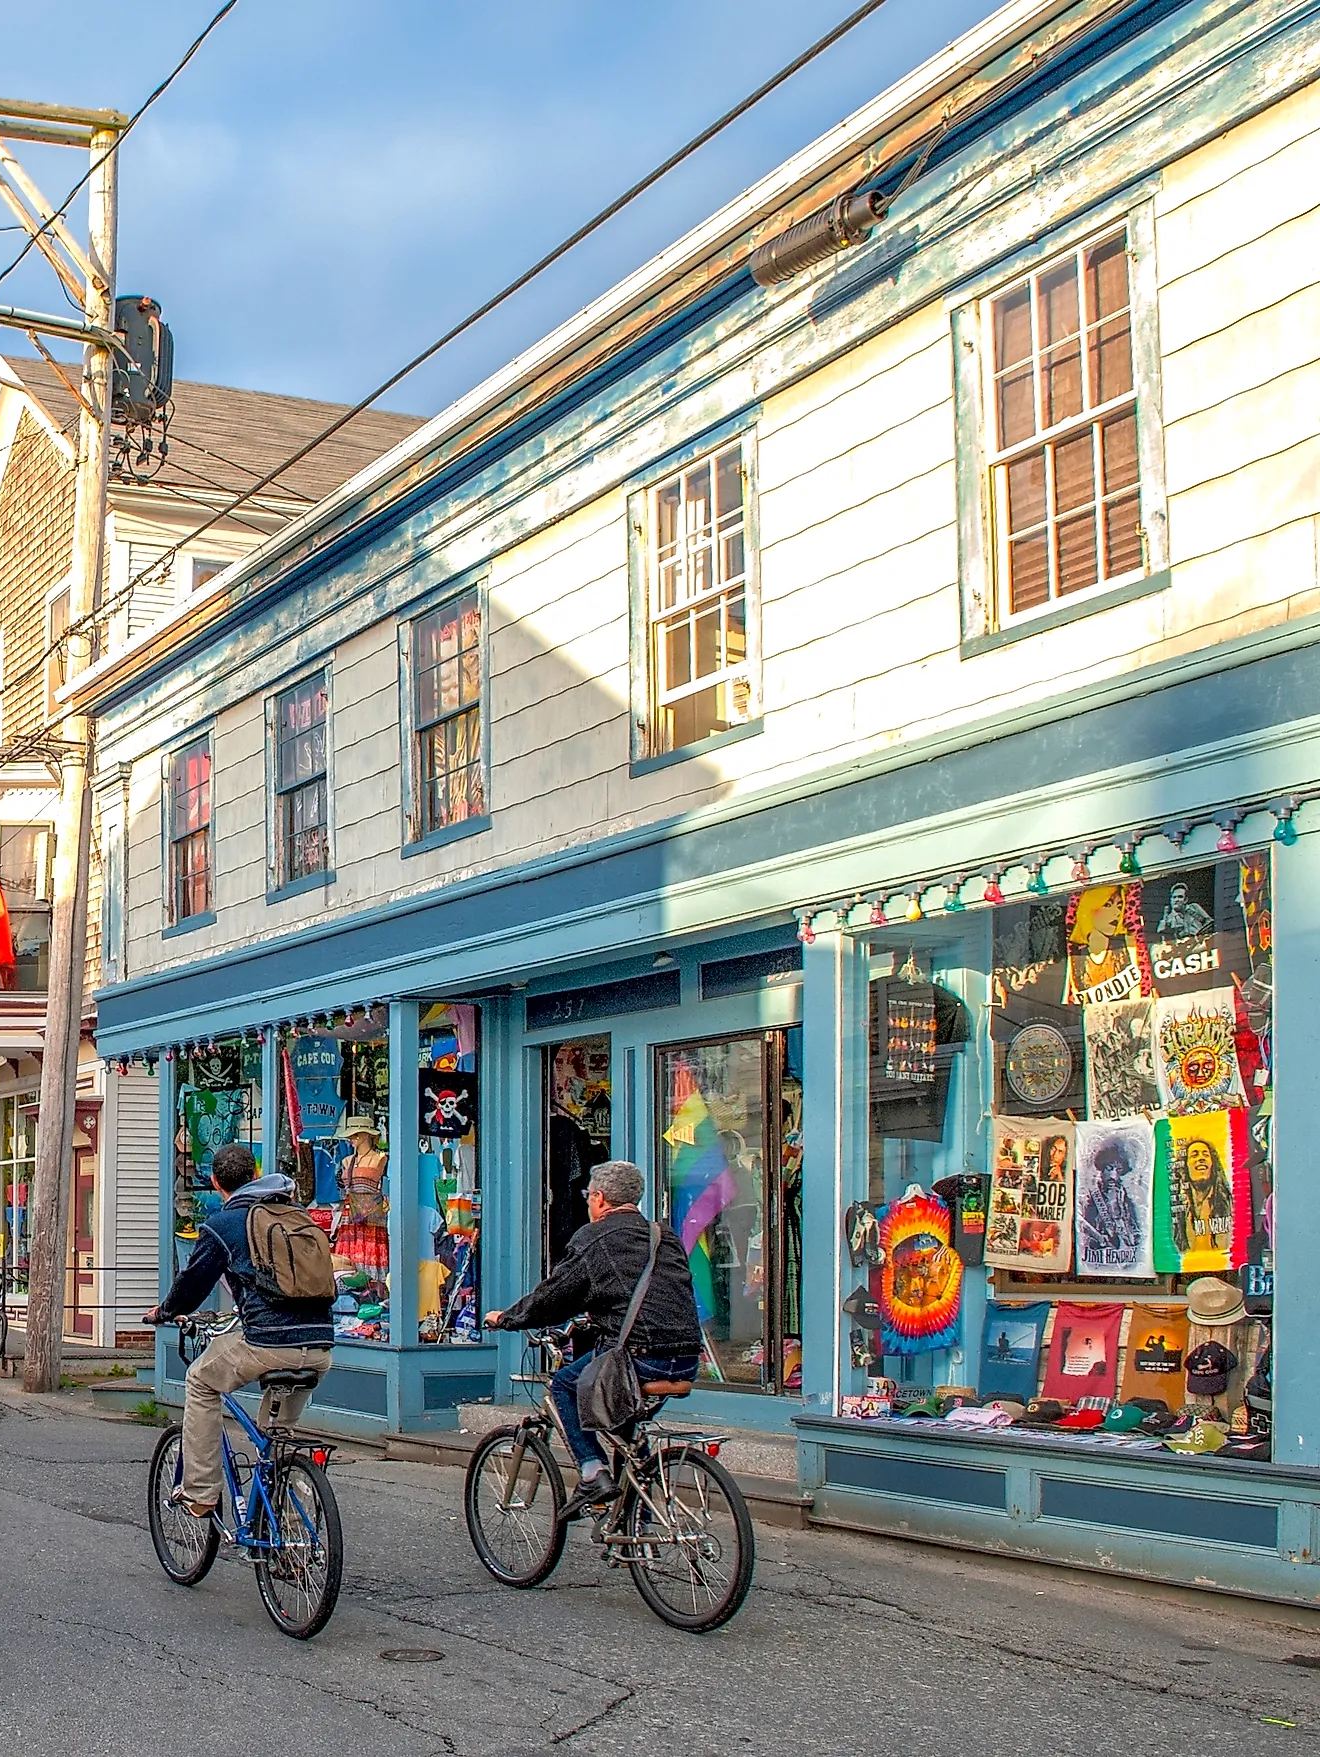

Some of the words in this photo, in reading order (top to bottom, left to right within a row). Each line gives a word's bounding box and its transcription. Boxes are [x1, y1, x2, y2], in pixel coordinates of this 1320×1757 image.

[1154, 948, 1221, 979] CASH
[243, 1052, 262, 1067] P-T
[297, 1052, 319, 1067] CAPE
[320, 1052, 336, 1066] COD
[247, 1107, 263, 1121] CAP
[1092, 1102, 1162, 1121] RADIOHEAD
[1037, 1183, 1067, 1206] BOB
[1037, 1206, 1066, 1221] MARLEY
[1082, 1246, 1104, 1264] JIMI
[1106, 1247, 1137, 1264] HENDRIX
[891, 1389, 932, 1399] CETOWN
